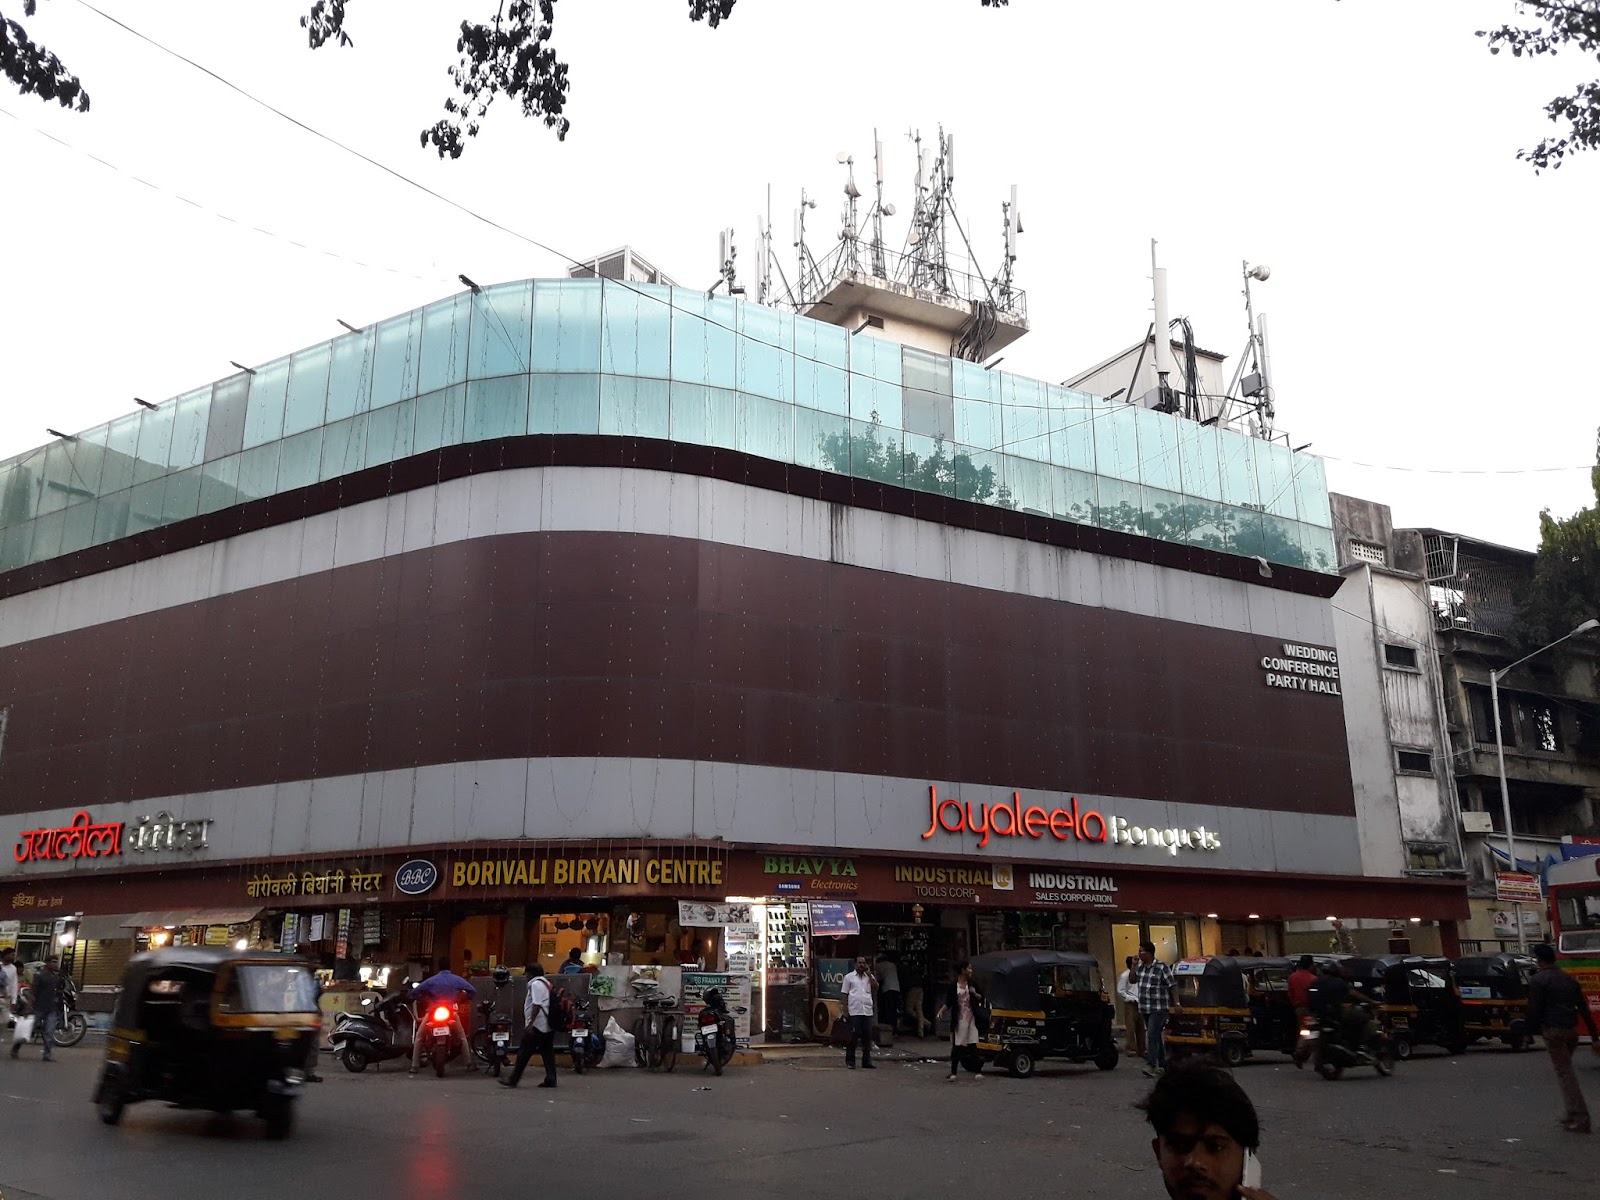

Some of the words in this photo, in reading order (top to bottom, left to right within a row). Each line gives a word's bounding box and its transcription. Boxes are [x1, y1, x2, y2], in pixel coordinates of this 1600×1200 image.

[1283, 643, 1337, 663] WEDDING
[1261, 656, 1339, 679] CONFERENCE
[1266, 672, 1307, 690] PARTY
[1308, 679, 1341, 695] HALL
[921, 785, 1107, 848] Jayaleela
[1110, 815, 1221, 856] Banquets
[452, 859, 547, 887] BORIVALI
[553, 858, 640, 885] BIRYANI
[646, 859, 723, 886] CENTRE
[763, 856, 858, 877] BHAVYA
[895, 865, 993, 886] INDUSTRIAL
[246, 871, 298, 898] बोरीवली
[400, 867, 431, 887] BBC
[811, 879, 858, 890] Electronics
[1028, 872, 1119, 892] INDUSTRIAL
[915, 886, 947, 897] TOOLS
[1035, 891, 1060, 901] SALES
[1060, 893, 1113, 904] CORPORATION
[820, 969, 844, 984] vivo
